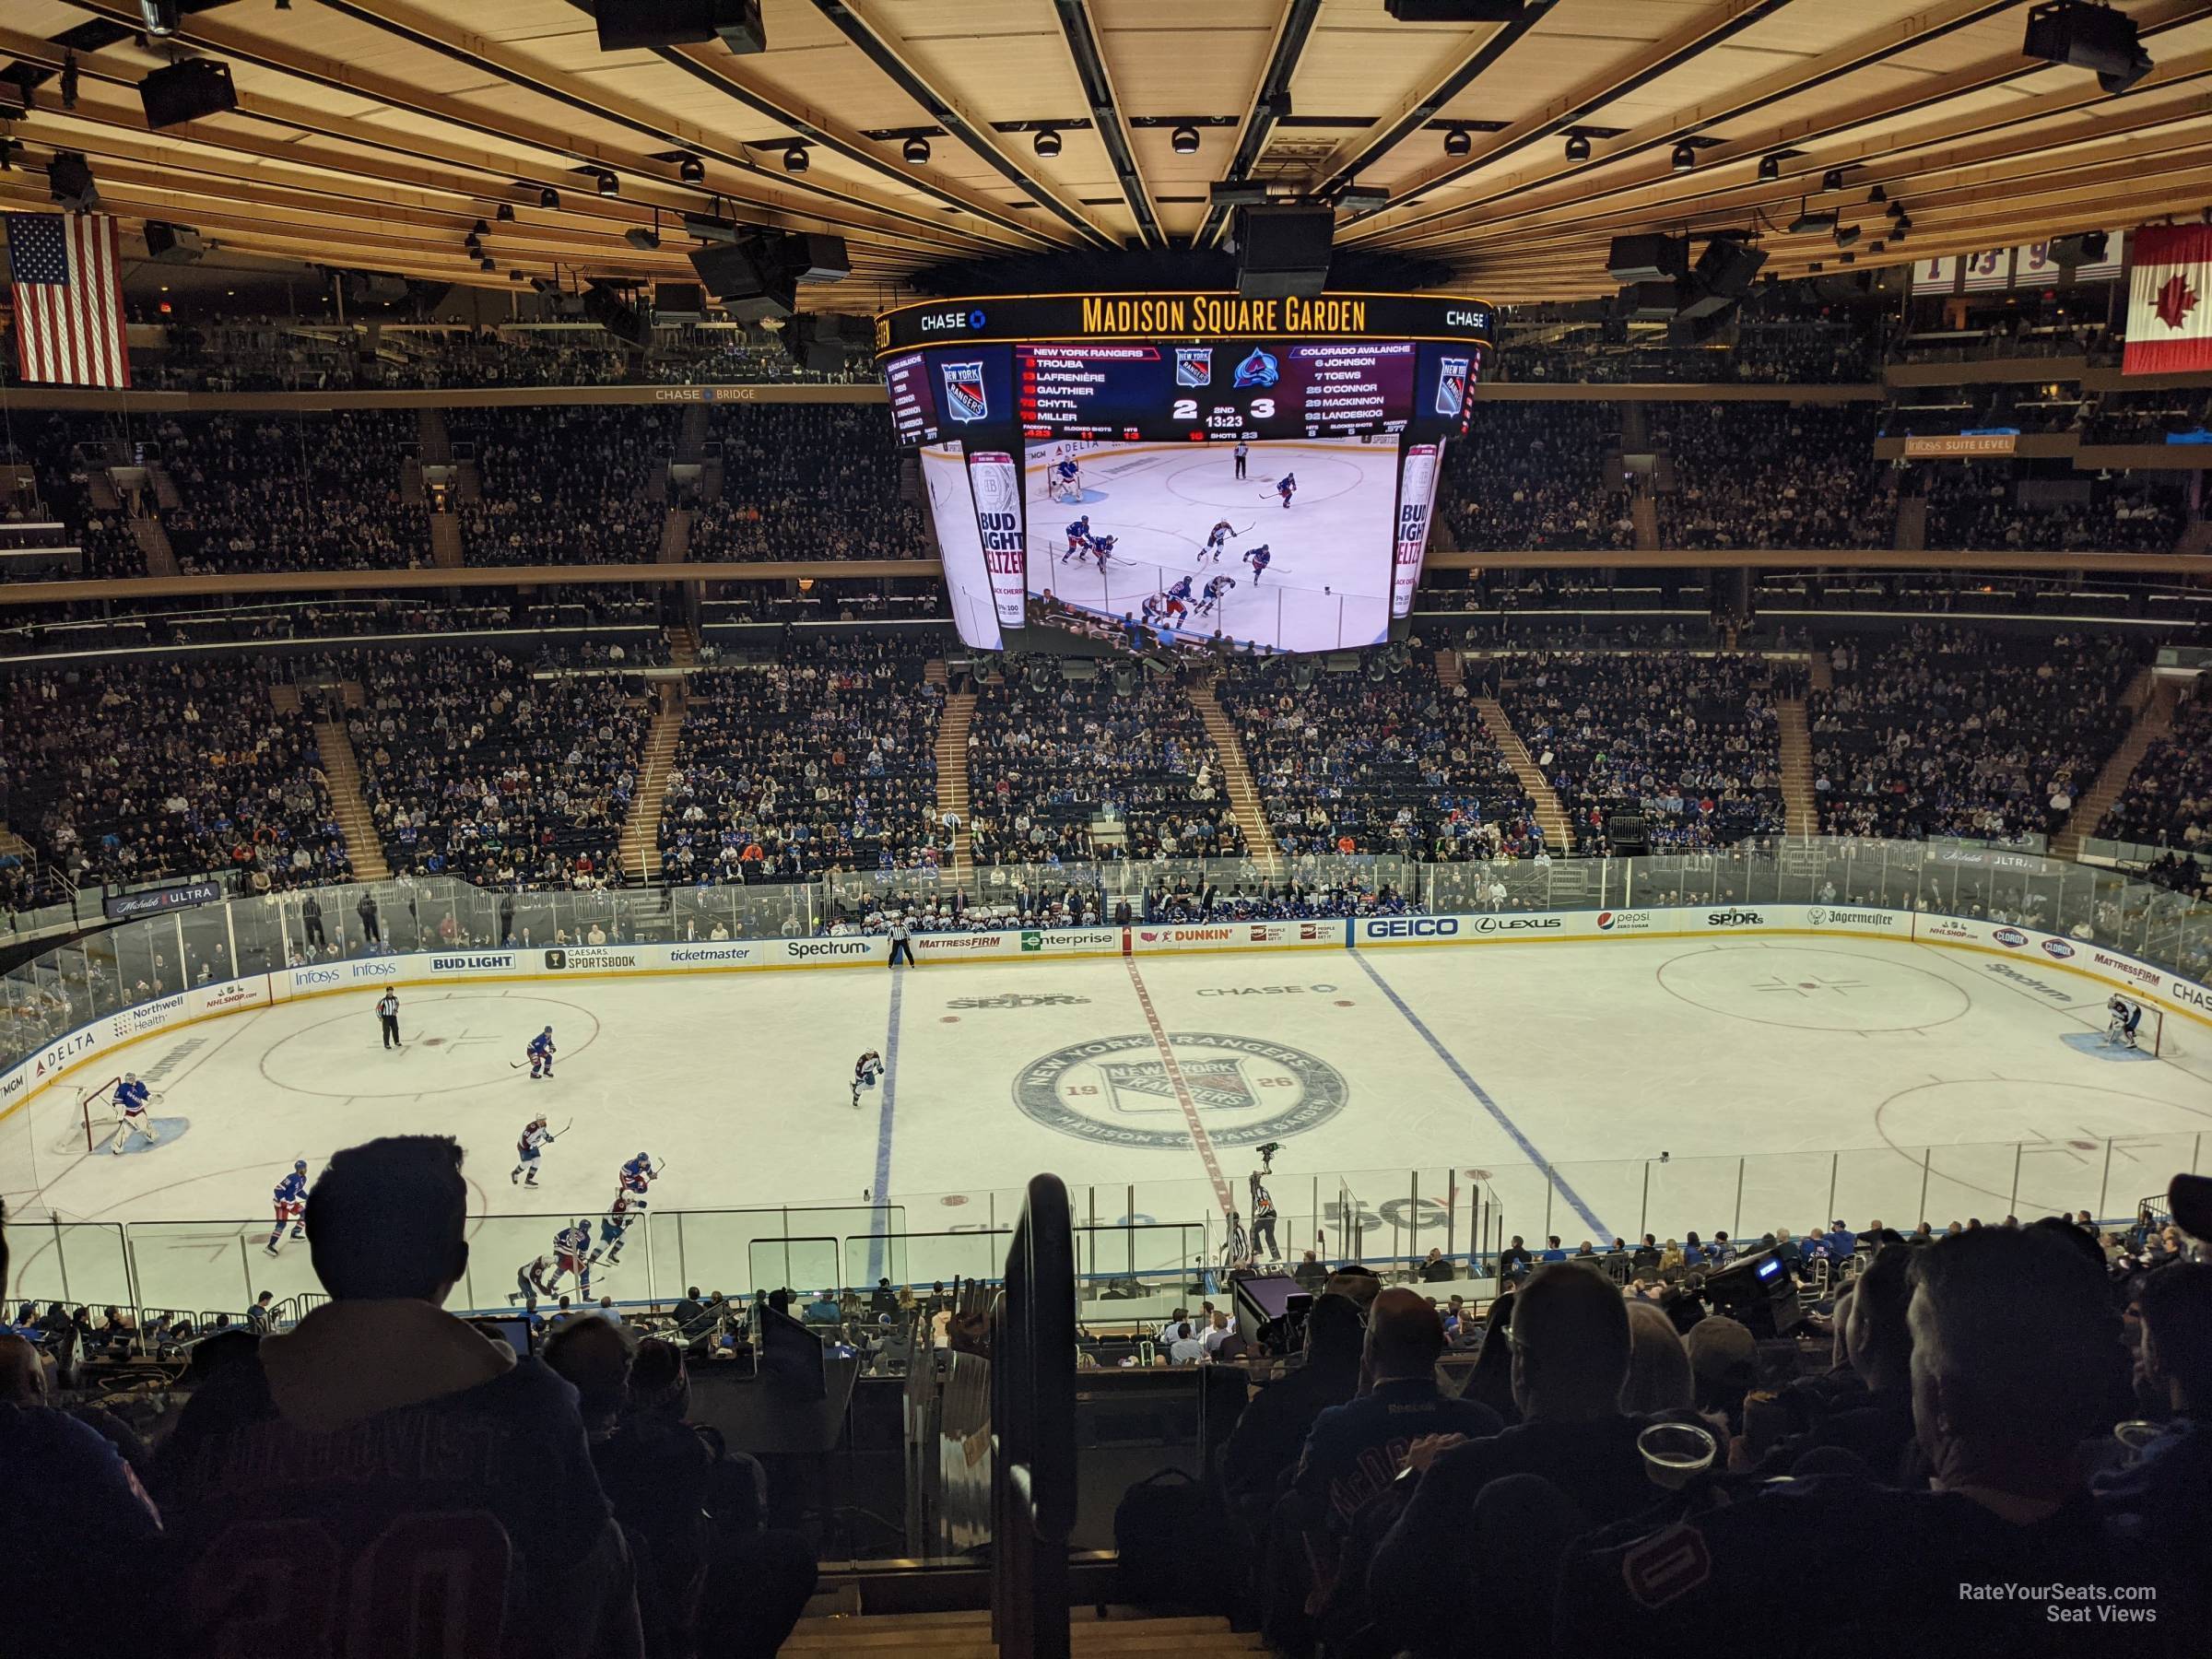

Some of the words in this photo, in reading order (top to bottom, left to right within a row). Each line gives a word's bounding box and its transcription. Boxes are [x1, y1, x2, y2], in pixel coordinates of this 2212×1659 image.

[922, 312, 966, 331] CHASE
[1083, 298, 1184, 333] MADISON
[1193, 296, 1277, 334] SQUARE
[1286, 296, 1365, 332] GARDEN
[1446, 311, 1483, 327] CHASE
[1090, 349, 1143, 358] RANGERS
[1300, 347, 1356, 356] COLORADO
[1357, 346, 1410, 355] AVALANCHE
[1037, 359, 1084, 369] TROUBA
[1324, 358, 1375, 367] JOHNSON
[959, 369, 979, 380] YORK
[1037, 372, 1105, 382] LAFRENIÈRE
[1314, 372, 1323, 381] 7
[1324, 371, 1361, 381] TOEWS
[655, 390, 700, 400] CHASE
[716, 389, 755, 399] BRIDGE
[1037, 386, 1094, 395] GAUTHIER
[1306, 386, 1322, 394] 25
[1324, 383, 1378, 394] O'CONNOR
[950, 383, 983, 415] RANGERS
[1037, 399, 1077, 408] CHYTIL
[1305, 399, 1321, 407] 29
[1323, 396, 1384, 406] MACKINNON
[1172, 399, 1197, 419] 2
[1250, 398, 1276, 418] 3
[1304, 412, 1321, 420] 92
[1322, 409, 1383, 420] LANDESKOG
[1037, 412, 1077, 422] MILLER
[1206, 416, 1242, 427] 13:23
[1947, 441, 1976, 451] SUITE
[1978, 440, 2009, 450] LEVEL
[980, 512, 1016, 531] BUD
[983, 532, 1023, 550] IGHT
[170, 888, 212, 903] ULTRA
[1617, 910, 1651, 923] pepsi
[1367, 918, 1458, 938] GEICO
[1499, 918, 1561, 929] LEXUS
[1028, 933, 1112, 947] enterprise
[1174, 928, 1233, 941] DUNKIN'
[1996, 931, 2026, 946] CLOROX
[568, 948, 607, 957] CAESARS
[670, 948, 750, 961] ticketmaster
[788, 941, 865, 959] Spectrum
[2044, 941, 2072, 956] CLOROX
[433, 959, 465, 970] BUD
[467, 956, 512, 968] LIGHT
[568, 956, 636, 969] SPORTSBOOK
[352, 962, 396, 977] Infosys
[296, 969, 339, 986] Infosys
[1195, 985, 1305, 997] CHASE
[2172, 982, 2212, 1013] CHAS
[133, 995, 184, 1019] Northwell
[135, 1014, 167, 1032] Health
[48, 1031, 95, 1067] DELTA
[1026, 1058, 1069, 1086] NEW
[1065, 1038, 1149, 1057] YORK
[1176, 1036, 1311, 1067] RANGERS
[1110, 1065, 1162, 1077] NEW
[1179, 1063, 1236, 1074] YORK
[1256, 1077, 1294, 1088] 26
[1065, 1085, 1099, 1096] 19
[1056, 1115, 1151, 1142] MADISON
[1273, 1099, 1330, 1130] GARDEN
